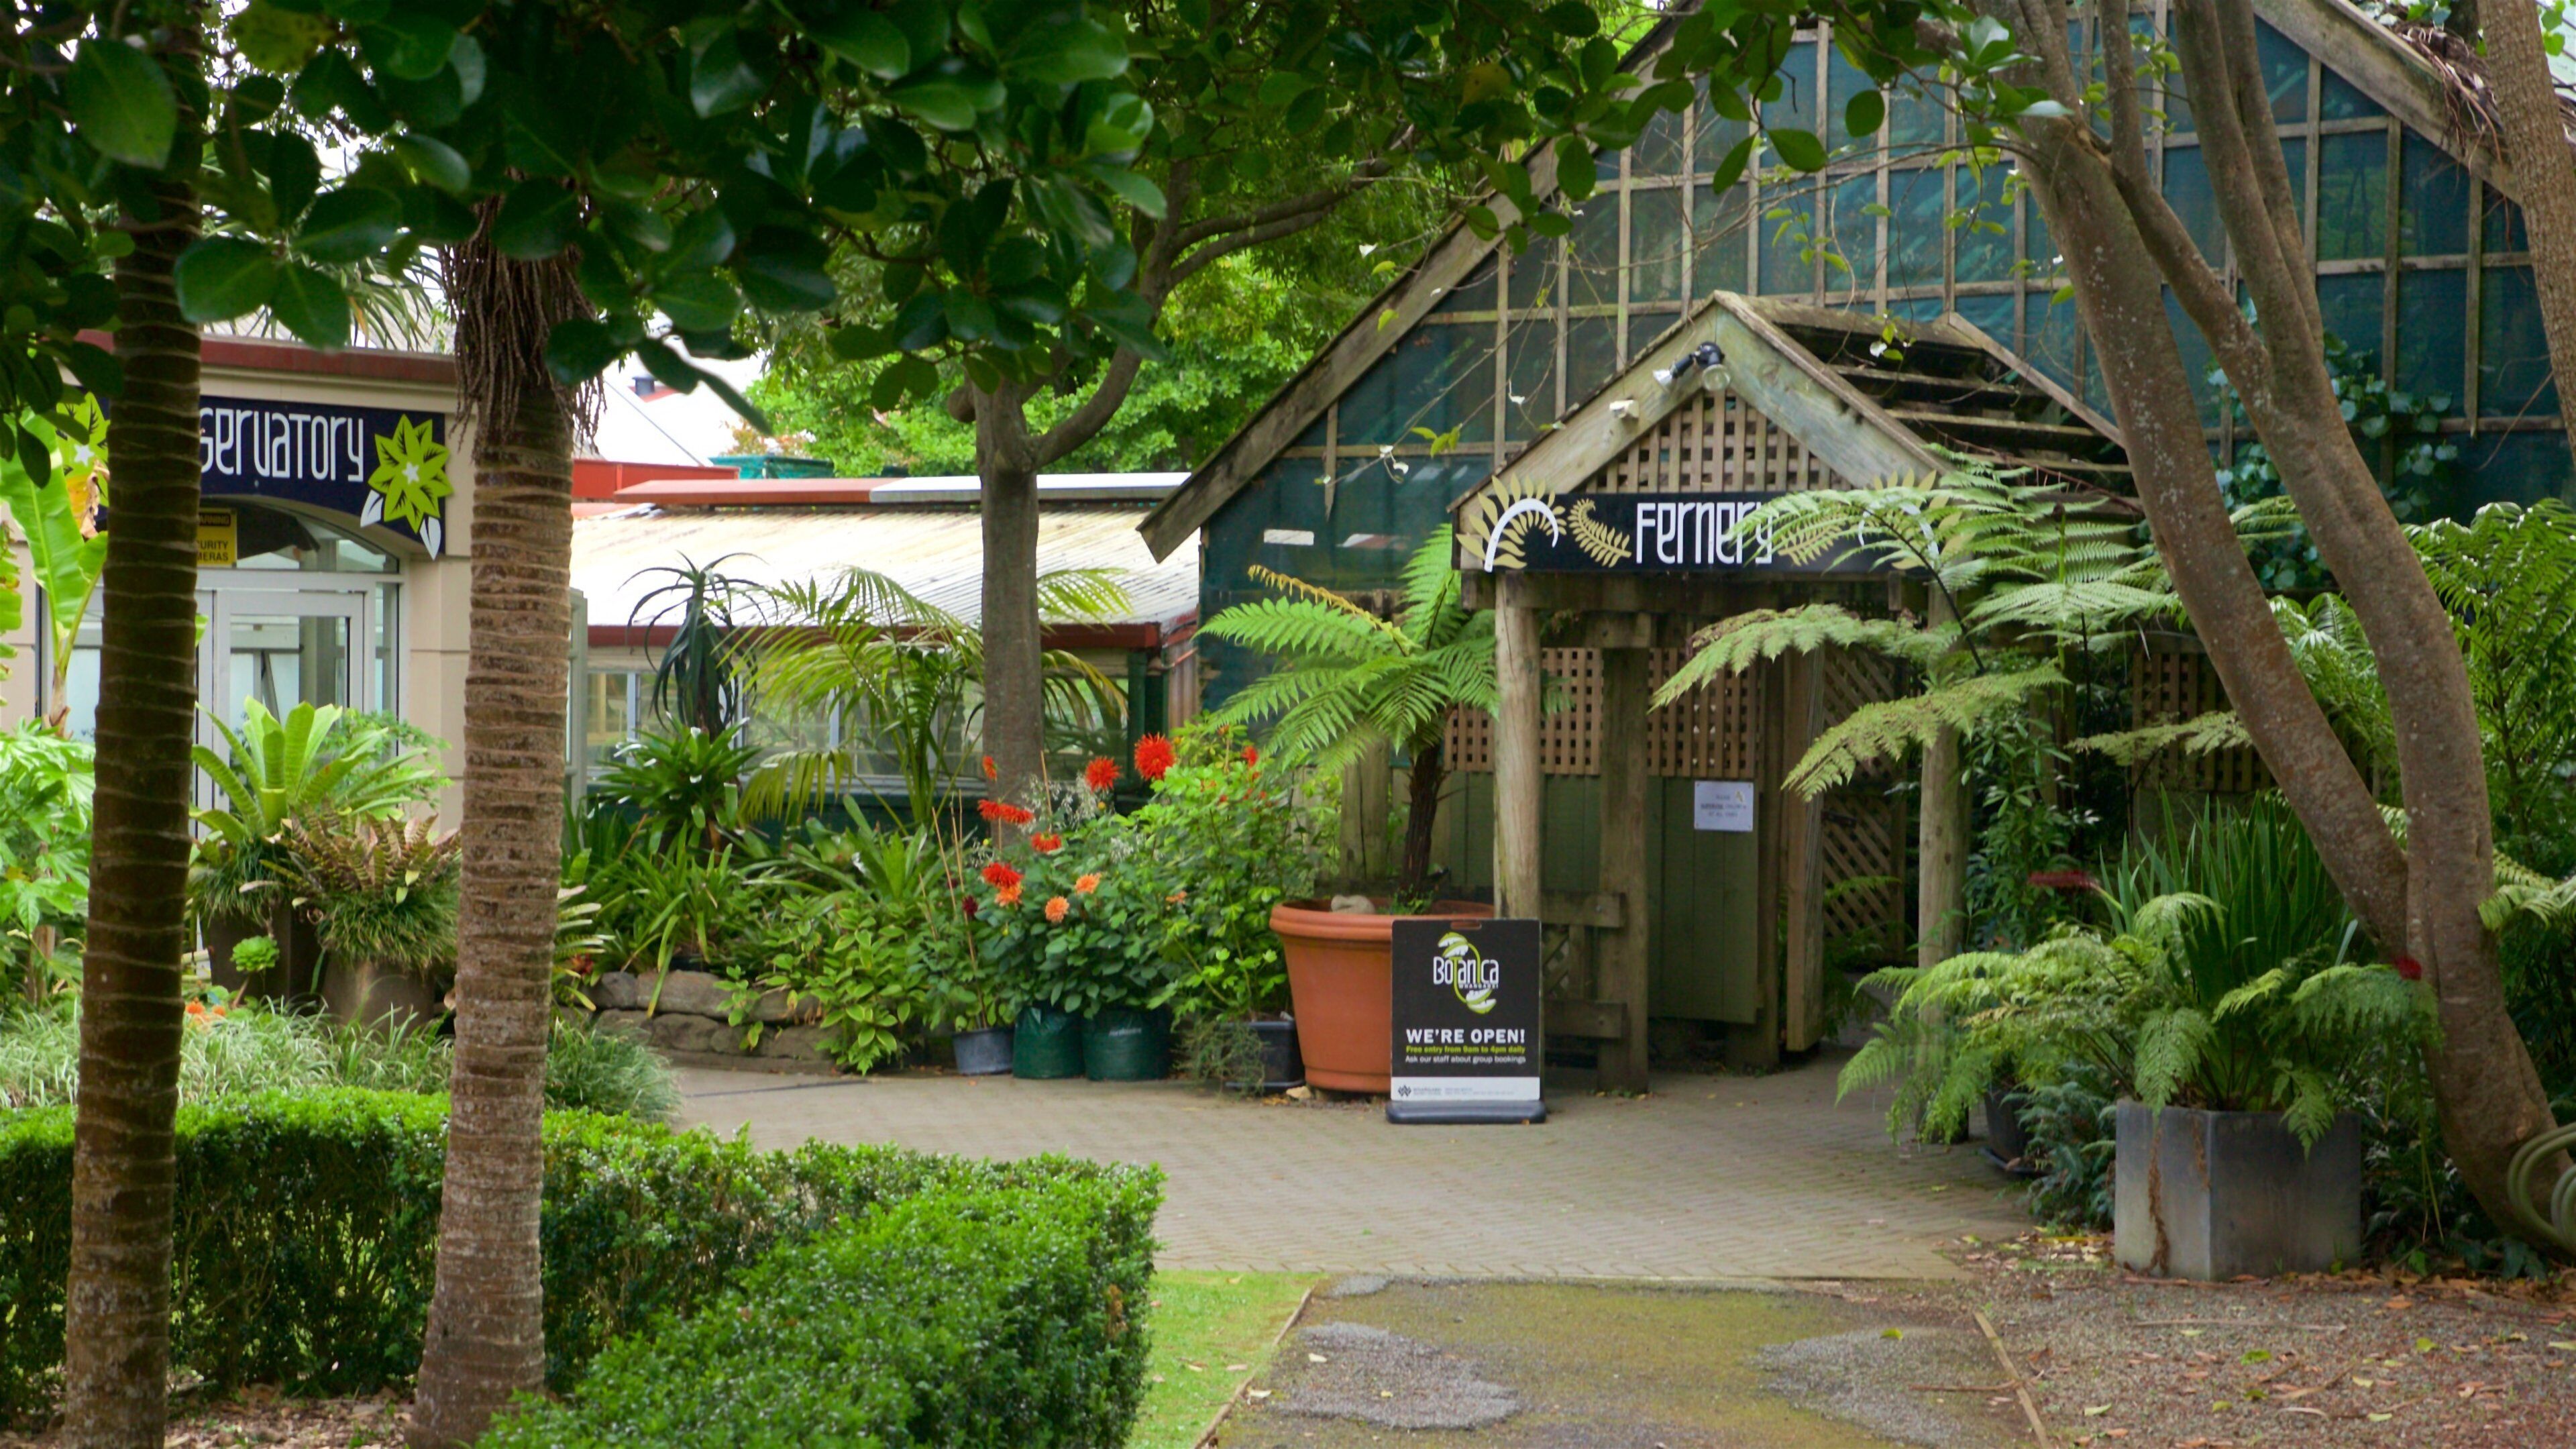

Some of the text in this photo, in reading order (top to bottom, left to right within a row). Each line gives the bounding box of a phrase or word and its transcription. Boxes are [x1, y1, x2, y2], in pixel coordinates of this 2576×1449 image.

[199, 407, 364, 482] servatory
[199, 515, 229, 525] ARNING
[1636, 502, 1772, 564] Fernery
[197, 551, 229, 561] MERAS
[1406, 1028, 1525, 1044] WE'RE OPEN!
[1406, 1045, 1423, 1054] Free
[1424, 1046, 1443, 1055] entry
[1444, 1046, 1461, 1054] from
[1490, 1045, 1507, 1055] 4pm
[1508, 1045, 1525, 1055] daily
[1405, 1055, 1418, 1063] Ask
[1433, 1055, 1450, 1063] staff
[1450, 1055, 1471, 1063] about
[1472, 1057, 1493, 1065] group
[1494, 1056, 1526, 1065] bookings
